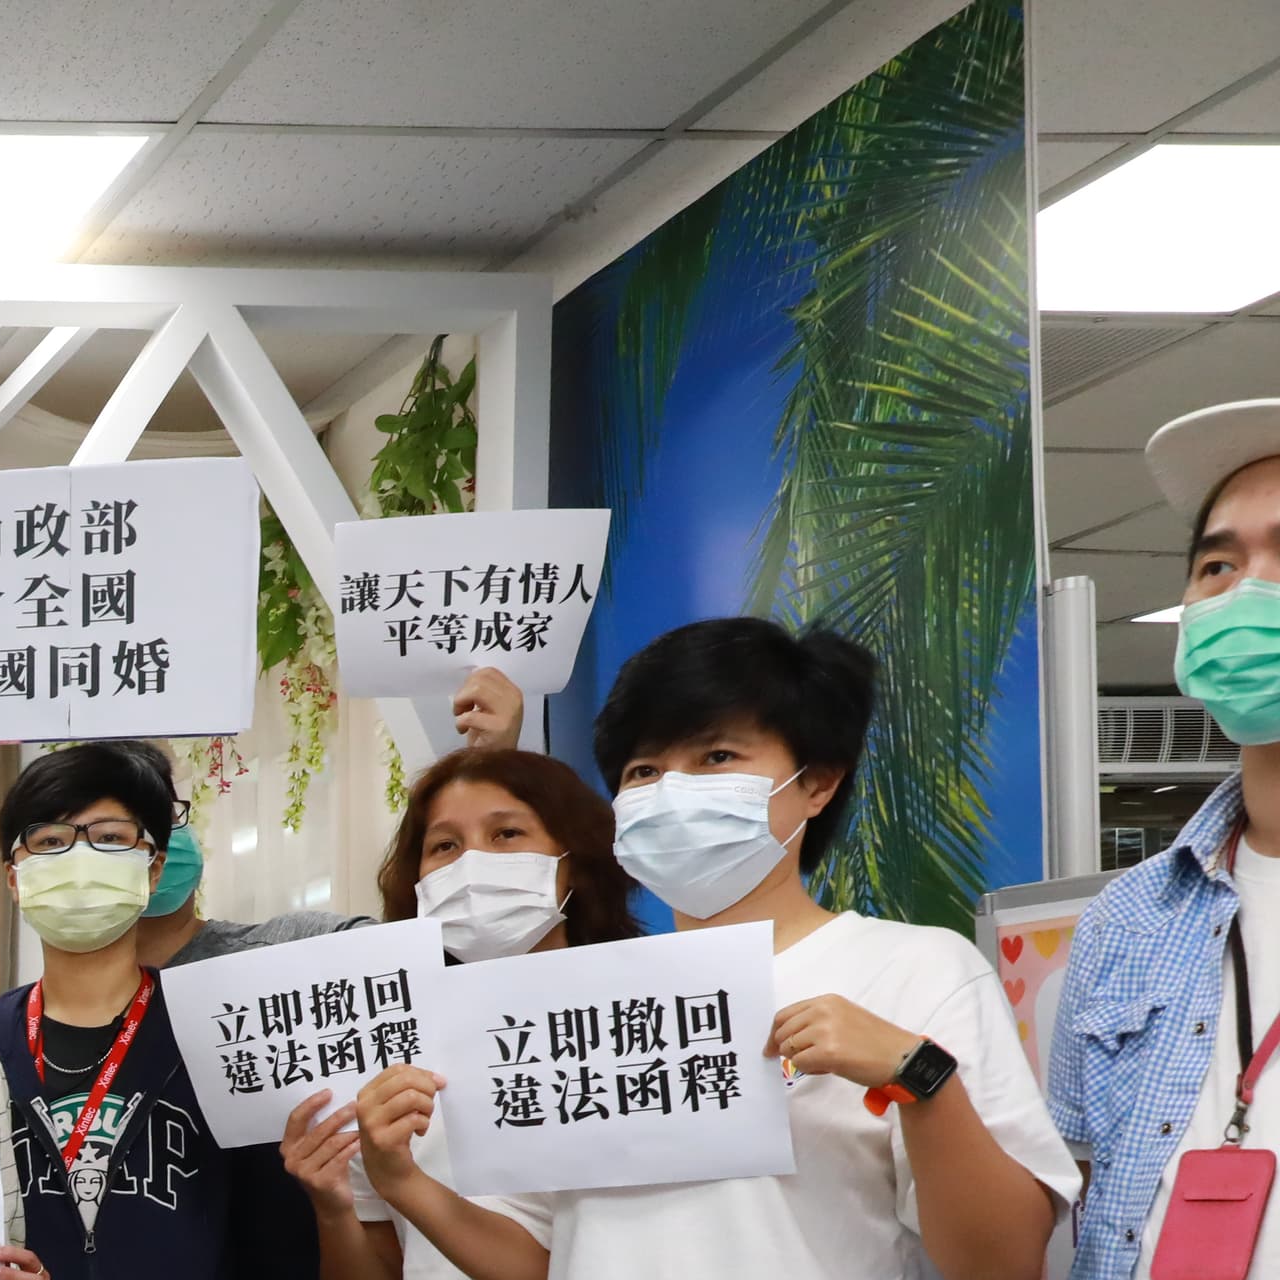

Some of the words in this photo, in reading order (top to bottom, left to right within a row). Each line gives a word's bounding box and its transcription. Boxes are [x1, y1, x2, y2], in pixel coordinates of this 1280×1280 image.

[339, 562, 595, 615] 讓天下有情人
[383, 610, 554, 657] 平等成家
[119, 1019, 138, 1046] Xintec
[210, 967, 413, 1050] 立即撤回
[486, 988, 732, 1070] 立即撤回
[97, 1062, 118, 1089] Xintec
[220, 1017, 423, 1096] 違法函釋
[491, 1051, 743, 1129] 違法函釋
[76, 1106, 96, 1137] Xintec
